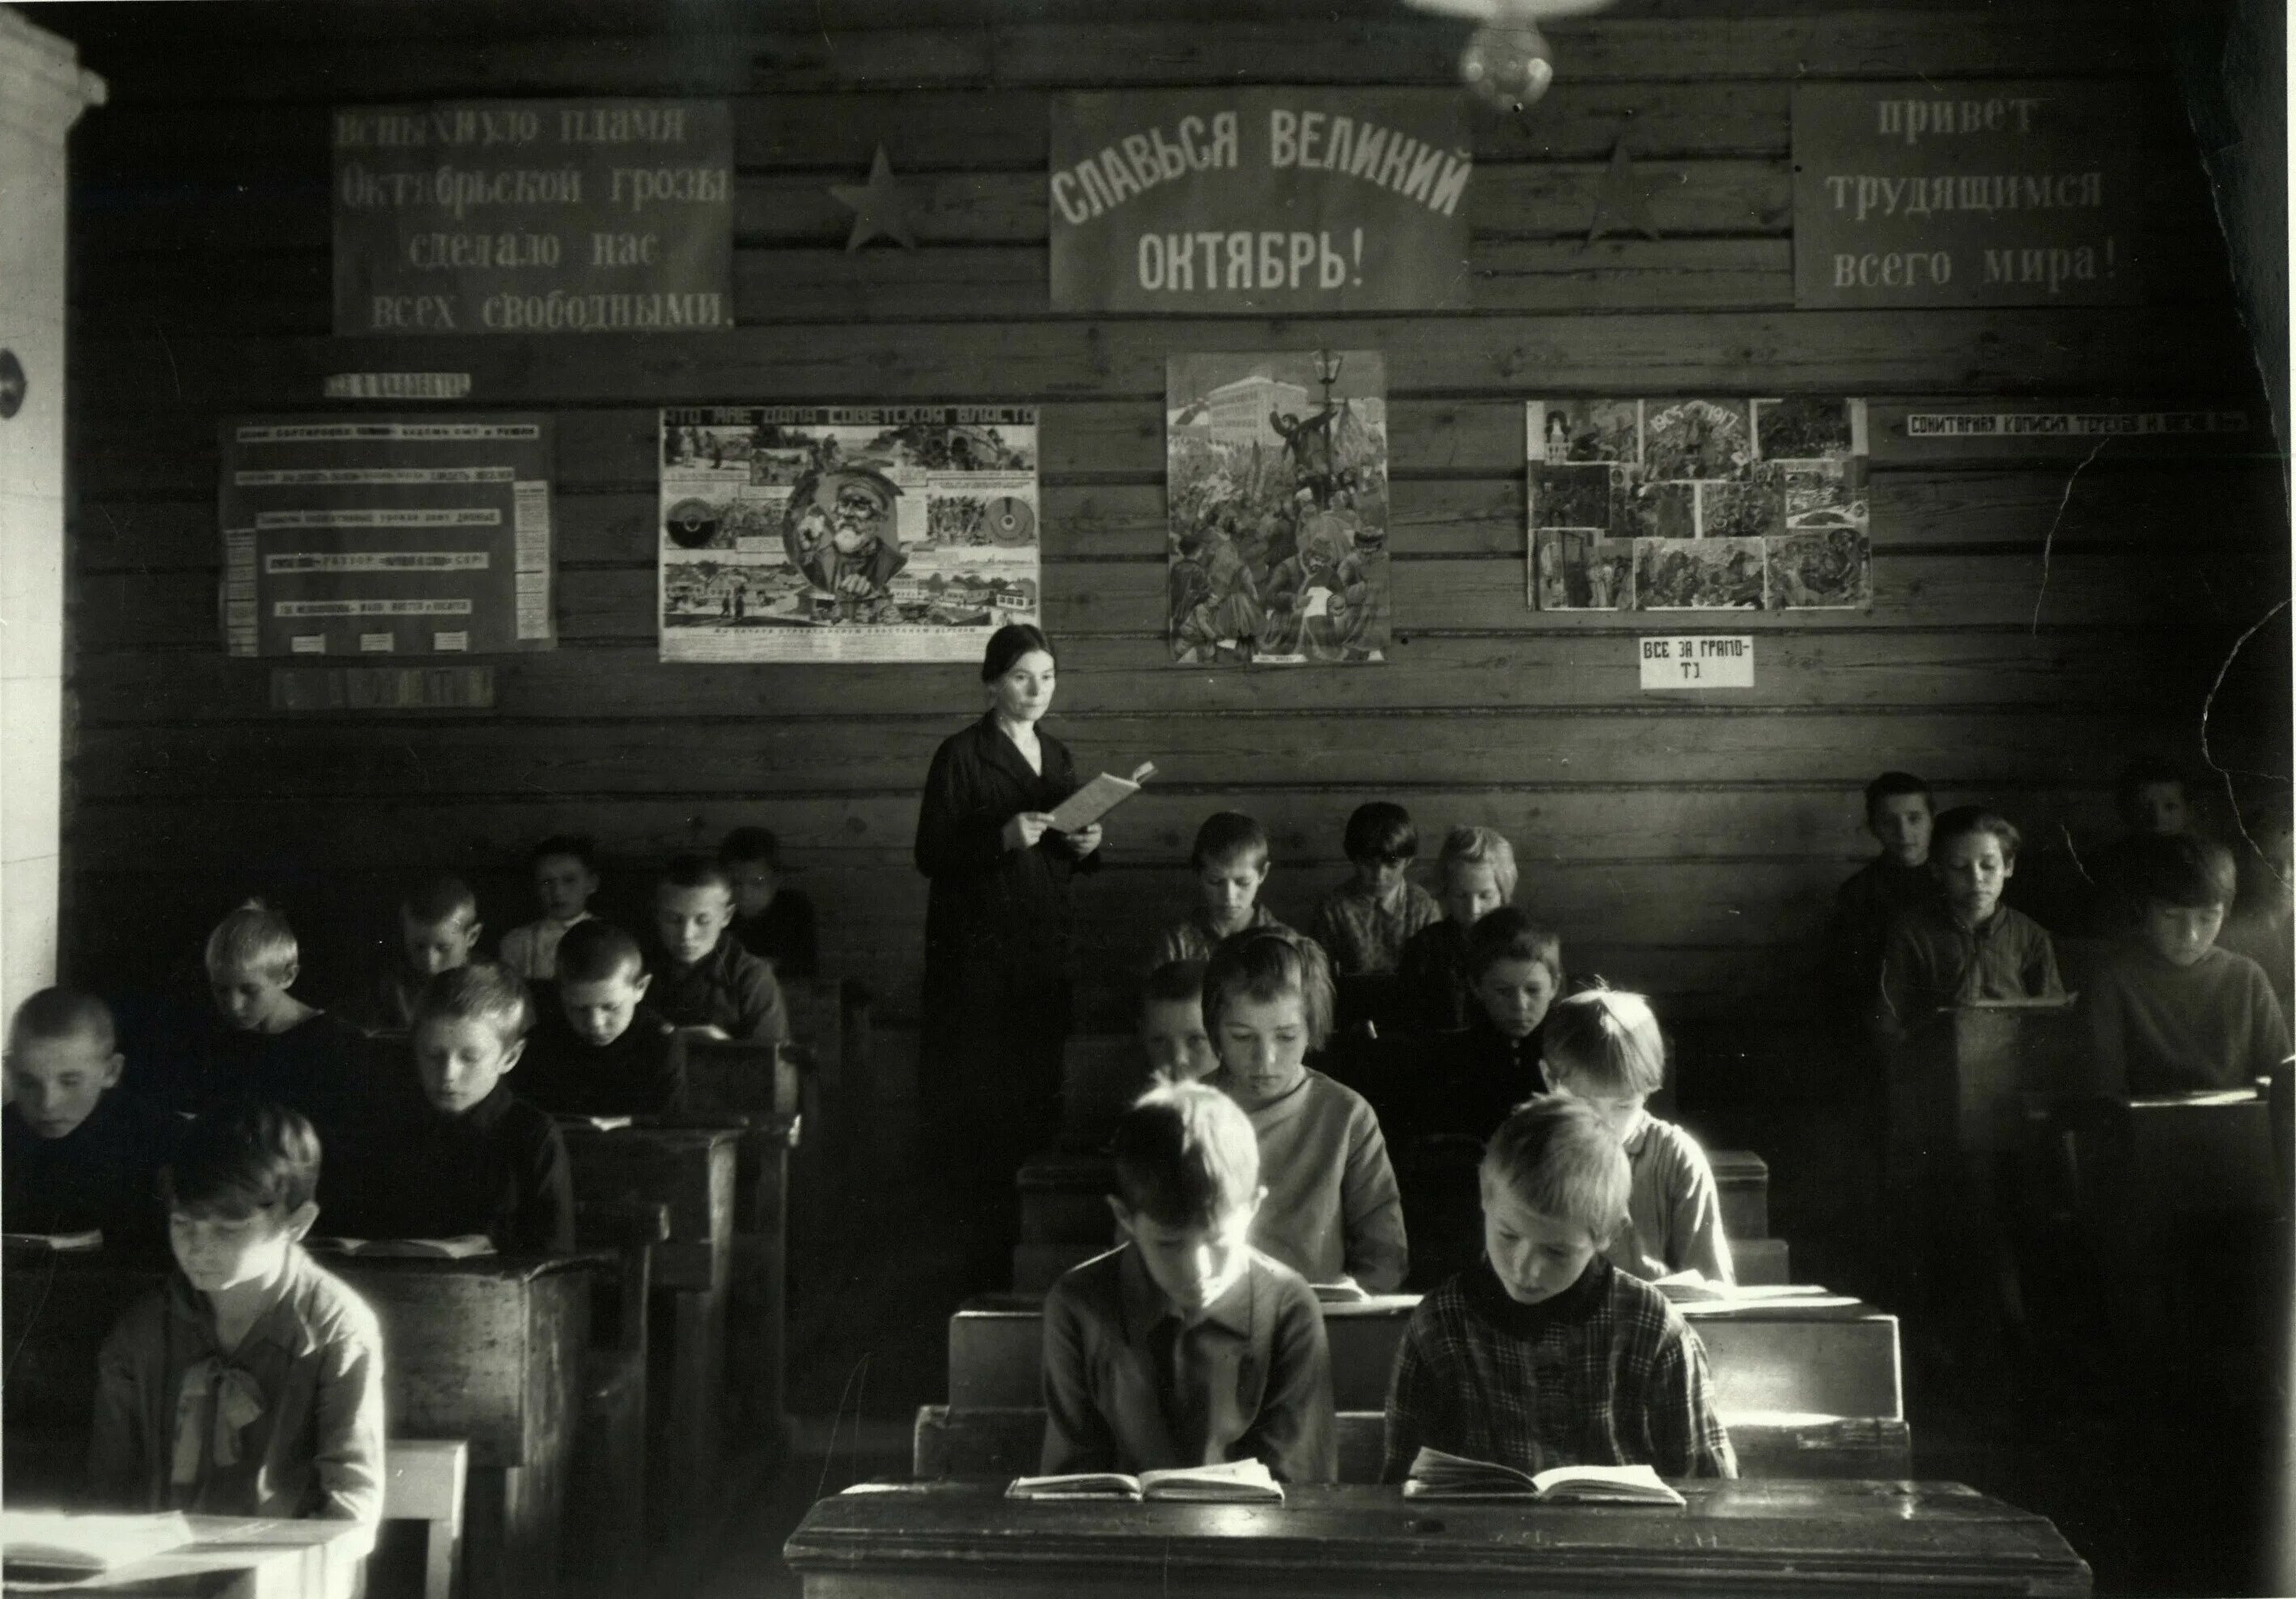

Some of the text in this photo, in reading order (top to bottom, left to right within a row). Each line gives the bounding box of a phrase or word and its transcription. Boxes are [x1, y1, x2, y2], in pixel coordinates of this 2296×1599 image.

[559, 108, 686, 144] пламя
[1878, 98, 2041, 145] привет
[1051, 108, 1473, 224] СЛАВЬСЯ ВЕЛИКИЙ
[609, 167, 730, 212] грозы
[1825, 172, 2103, 221] трудящимся
[409, 232, 660, 270] сделало нас
[1138, 227, 1364, 291] ОКТЯБРЬ!
[1833, 235, 2116, 294] всего мира!
[372, 294, 456, 329] всех
[828, 406, 945, 424] СОВЕТСКАЯ
[1706, 405, 1738, 435] 1917
[1644, 641, 1670, 659] ВСЕ
[1678, 641, 1693, 658] ЗА
